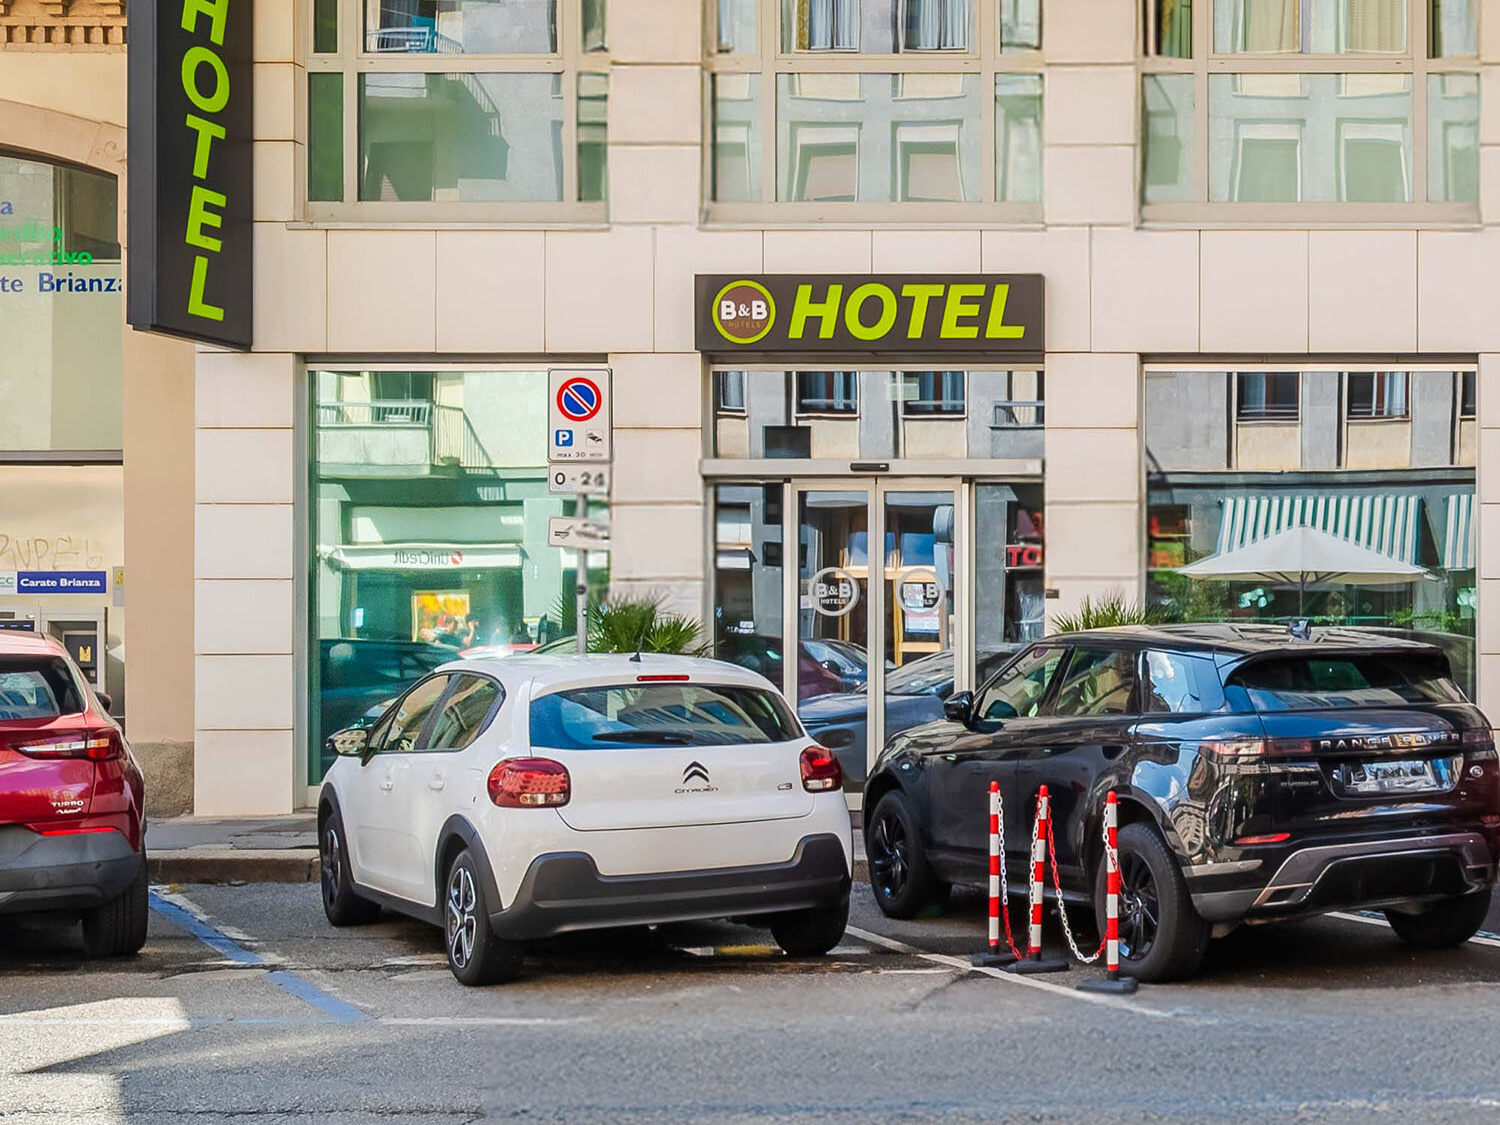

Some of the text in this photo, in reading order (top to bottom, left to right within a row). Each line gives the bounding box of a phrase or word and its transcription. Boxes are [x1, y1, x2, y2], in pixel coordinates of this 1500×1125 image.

[721, 300, 768, 320] B&B
[787, 283, 1026, 341] HOTEL
[558, 430, 570, 446] P
[20, 578, 58, 587] Carate
[60, 578, 101, 587] Brianza
[1319, 736, 1389, 750] RANGE
